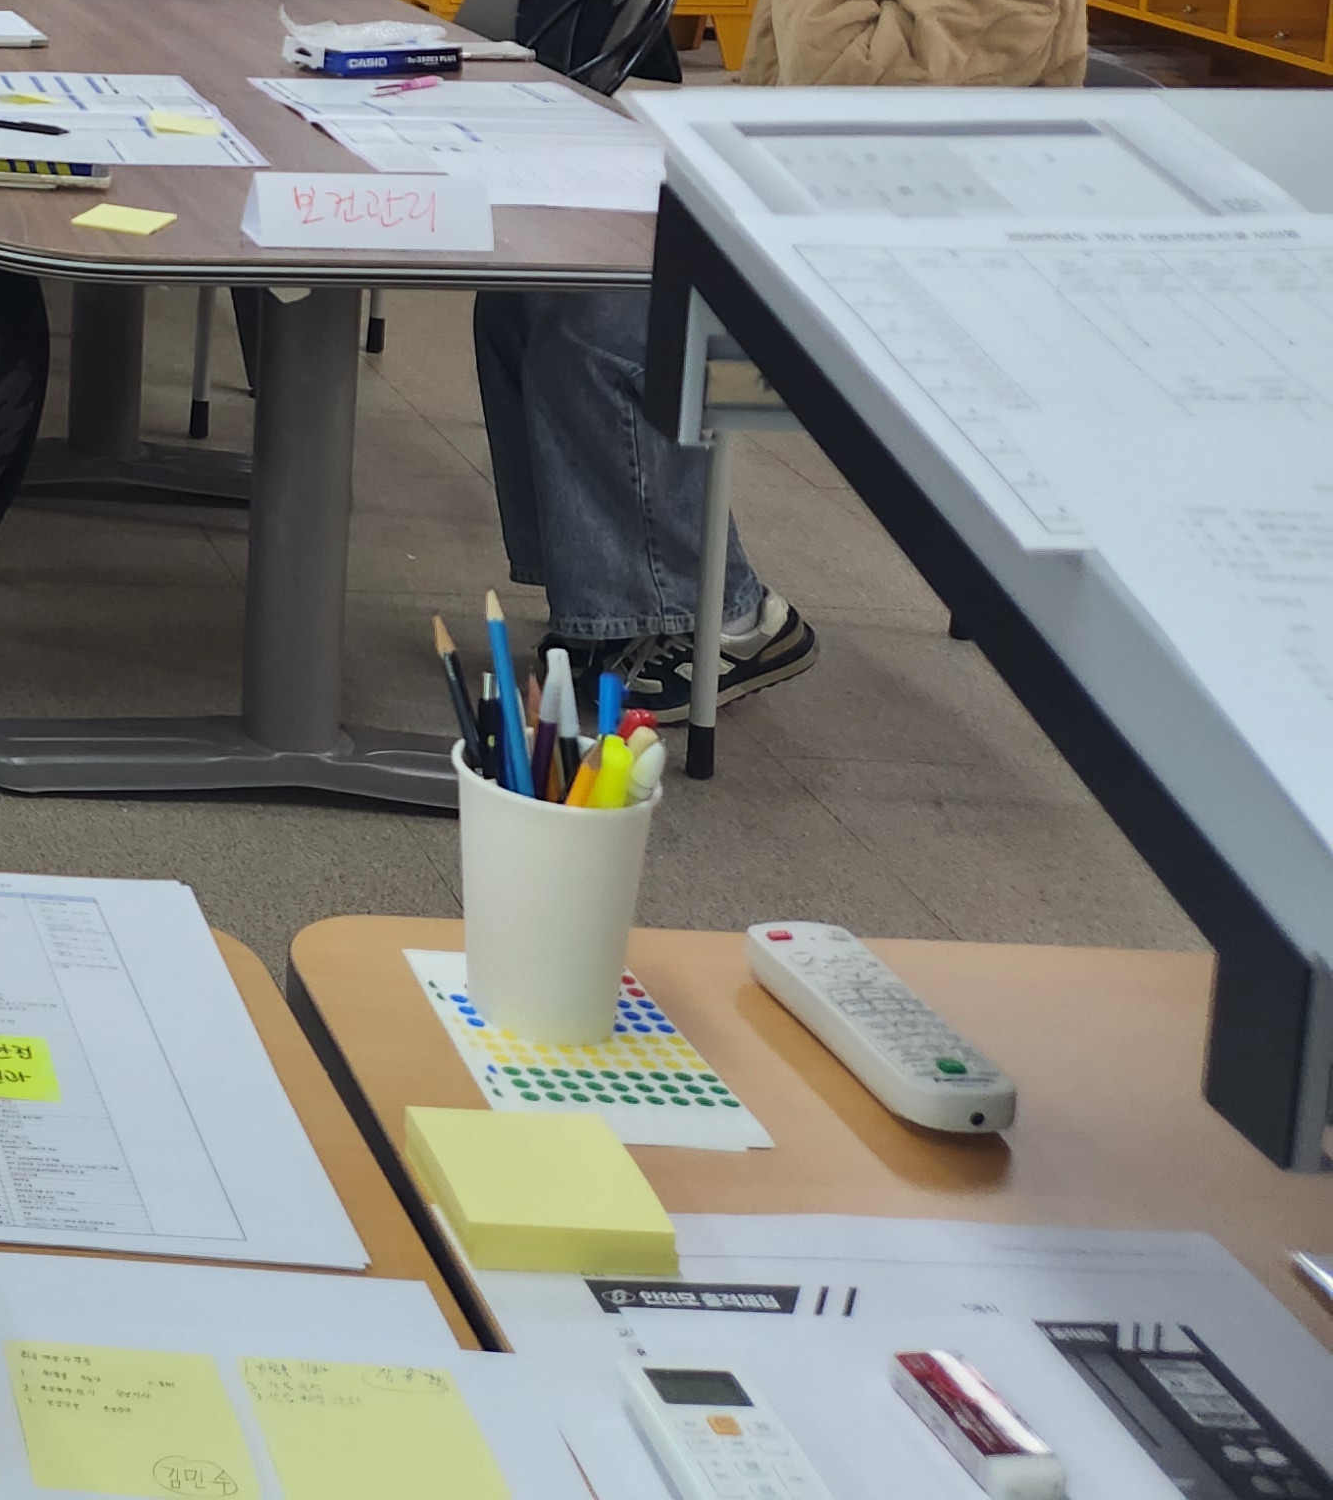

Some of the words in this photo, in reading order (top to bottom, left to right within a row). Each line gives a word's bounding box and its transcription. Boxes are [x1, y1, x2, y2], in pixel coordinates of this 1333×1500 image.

[347, 57, 388, 69] CASIO
[294, 186, 437, 233] 보건관리
[161, 1466, 231, 1494] 김민수
